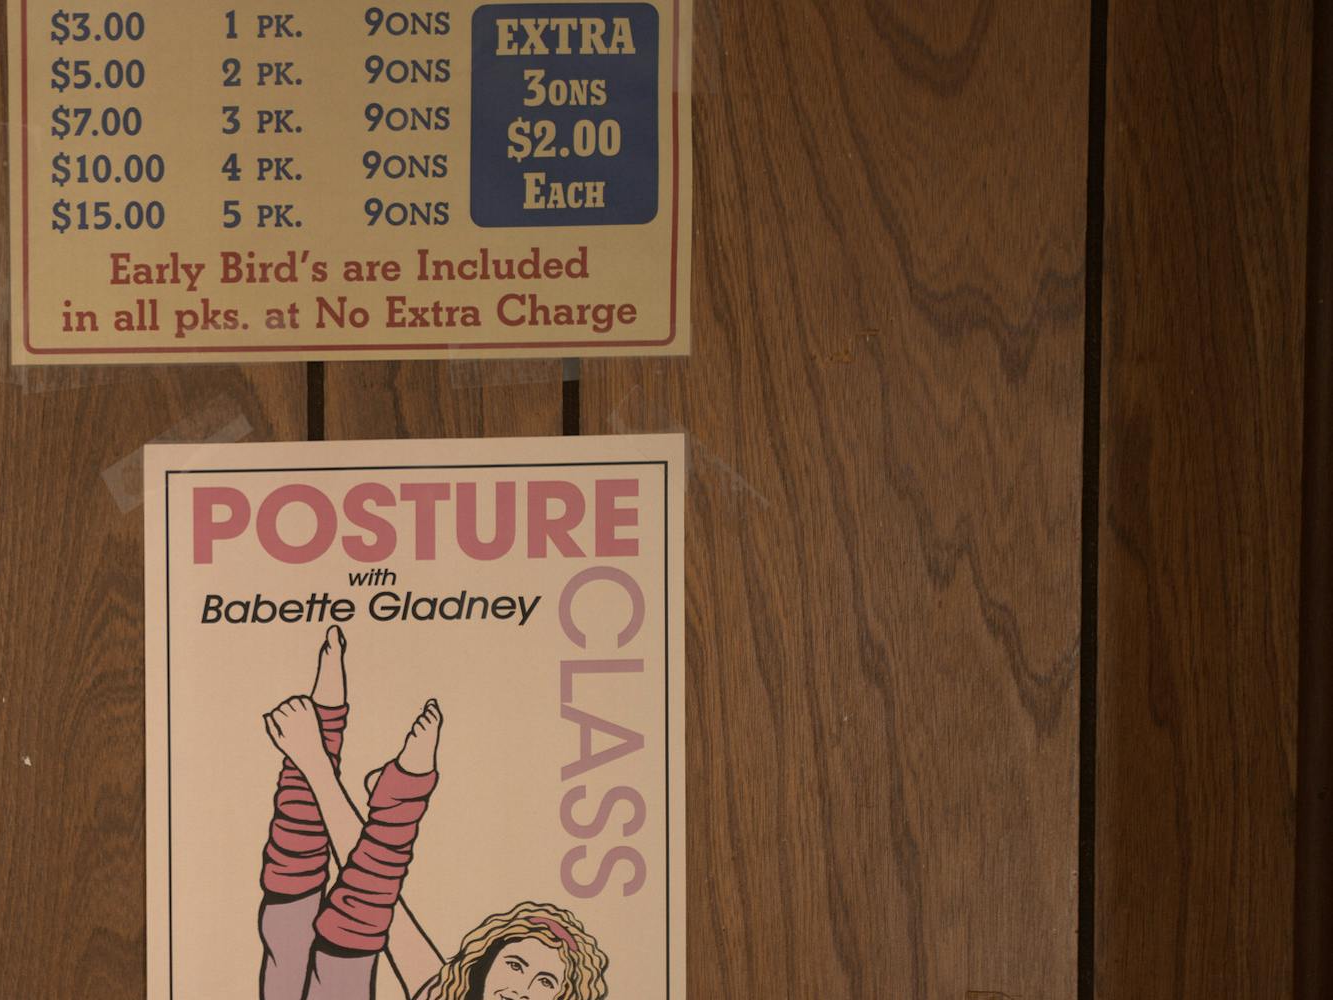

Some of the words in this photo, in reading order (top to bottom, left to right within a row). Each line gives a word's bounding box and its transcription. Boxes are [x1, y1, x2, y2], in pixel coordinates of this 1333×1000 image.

[51, 9, 146, 45] $3.00
[225, 10, 238, 38] 1
[257, 14, 303, 38] PK.
[496, 17, 636, 56] EXTRA
[51, 57, 146, 92] $5.00
[222, 57, 241, 86] 2
[257, 61, 303, 86] PK.
[51, 104, 143, 140] $7.00
[222, 106, 241, 135] 3
[257, 109, 303, 134] PK.
[507, 116, 622, 163] $2.00
[51, 151, 166, 187] $10.00
[221, 153, 242, 181] 4
[257, 157, 303, 181] PK.
[51, 198, 166, 234] $15.00
[222, 200, 241, 229] 5
[257, 204, 303, 228] PK.
[110, 250, 205, 291] Early
[220, 250, 328, 285] Bird's
[343, 258, 402, 281] are
[417, 246, 589, 281] Included
[62, 300, 99, 332] in
[114, 299, 160, 332] all
[174, 297, 249, 338] pks.
[265, 301, 300, 331] at
[316, 296, 370, 329] No
[386, 295, 482, 328] Extra
[497, 292, 638, 333] Charge
[193, 478, 639, 564] POSTURE
[347, 568, 397, 587] with
[202, 592, 356, 625] Babette
[368, 589, 541, 626] Gladney
[559, 566, 647, 899] CLASS
